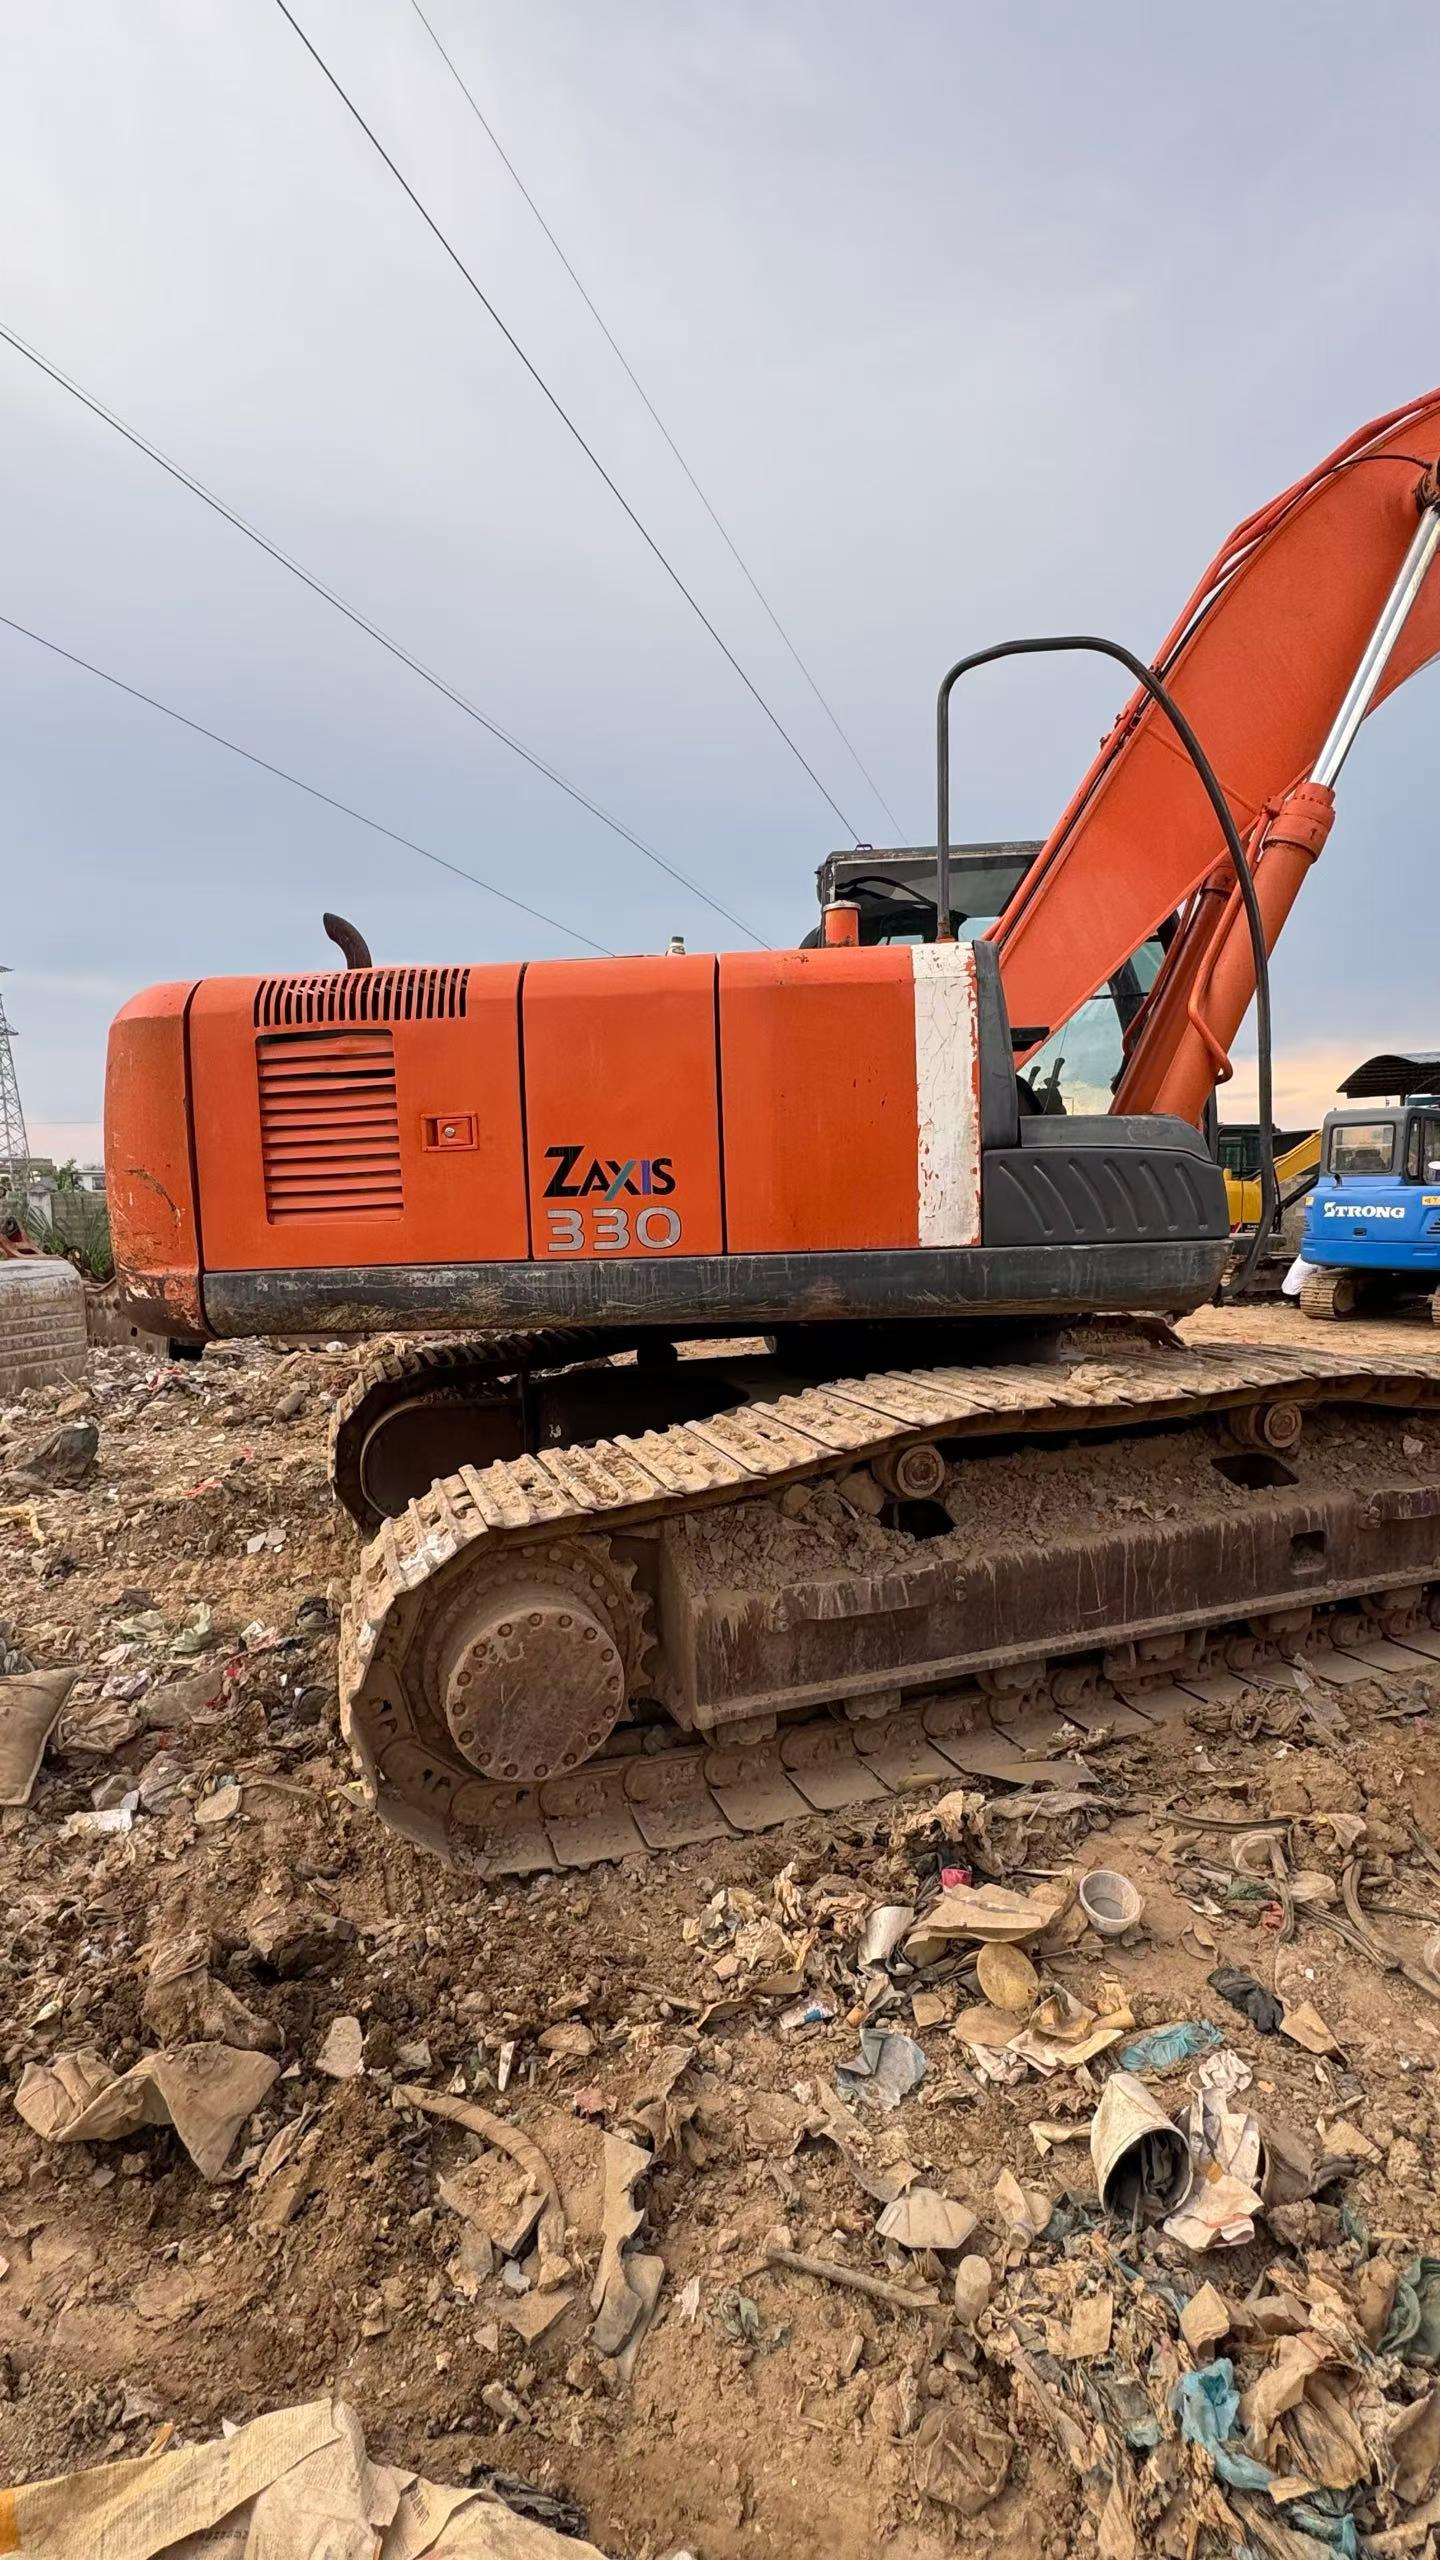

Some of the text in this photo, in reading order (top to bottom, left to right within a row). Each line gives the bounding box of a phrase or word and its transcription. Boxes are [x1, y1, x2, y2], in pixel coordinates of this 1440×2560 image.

[543, 1145, 676, 1201] ZAXIS
[547, 1206, 682, 1252] 330
[1323, 1201, 1405, 1219] STRONG
